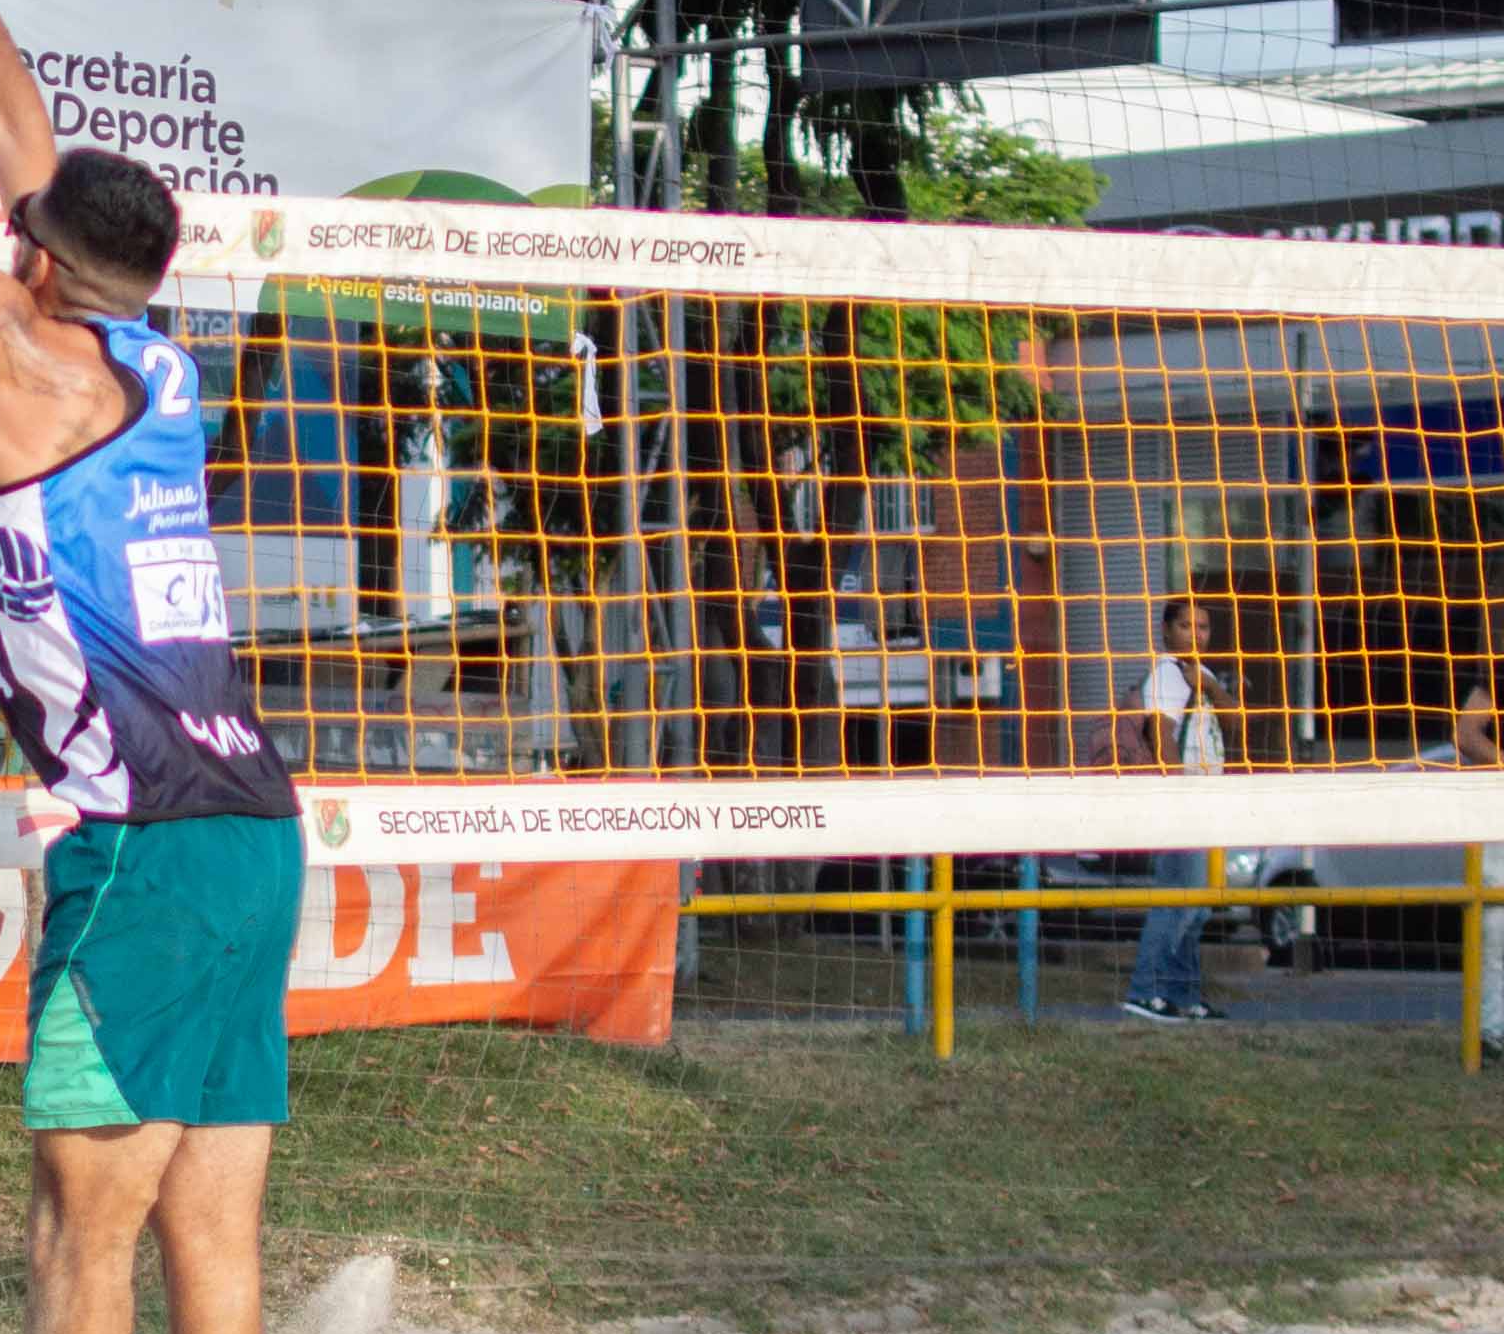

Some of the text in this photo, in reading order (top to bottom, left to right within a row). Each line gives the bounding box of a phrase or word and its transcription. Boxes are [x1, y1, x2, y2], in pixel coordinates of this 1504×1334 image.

[16, 46, 216, 105] ecretaría
[53, 91, 245, 156] Deporte
[178, 224, 223, 246] EIRA
[308, 221, 746, 267] SECRETARÍA DE RECREACIÓN Y DEPORTE
[384, 282, 426, 304] está
[432, 288, 549, 315] cambiando!
[142, 343, 192, 417] 2
[379, 802, 826, 835] SECRETARÍA DE RECREACIÓN Y DEPORTE
